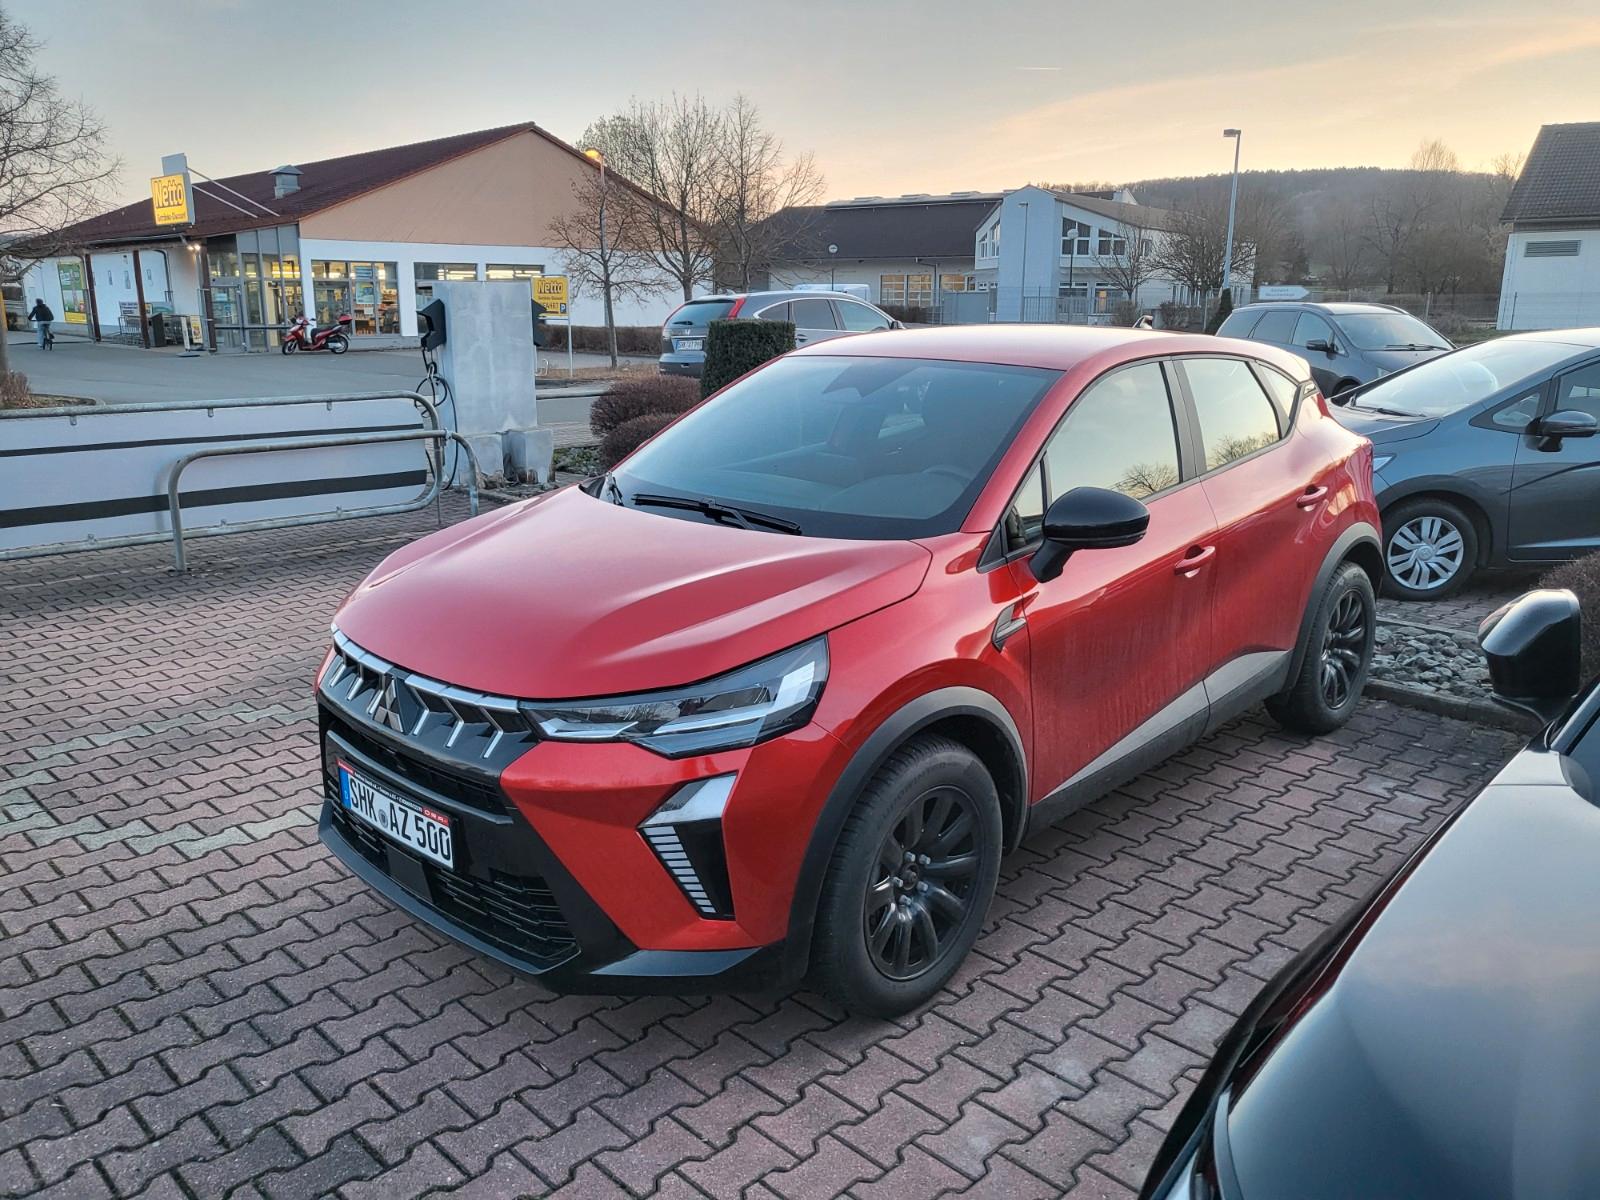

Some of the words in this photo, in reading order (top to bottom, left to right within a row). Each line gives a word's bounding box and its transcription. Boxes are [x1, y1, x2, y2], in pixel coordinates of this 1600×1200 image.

[153, 179, 184, 208] Netto
[537, 280, 563, 294] Netto
[350, 778, 377, 822] SHK
[389, 802, 412, 841] AZ
[414, 814, 451, 861] 500
